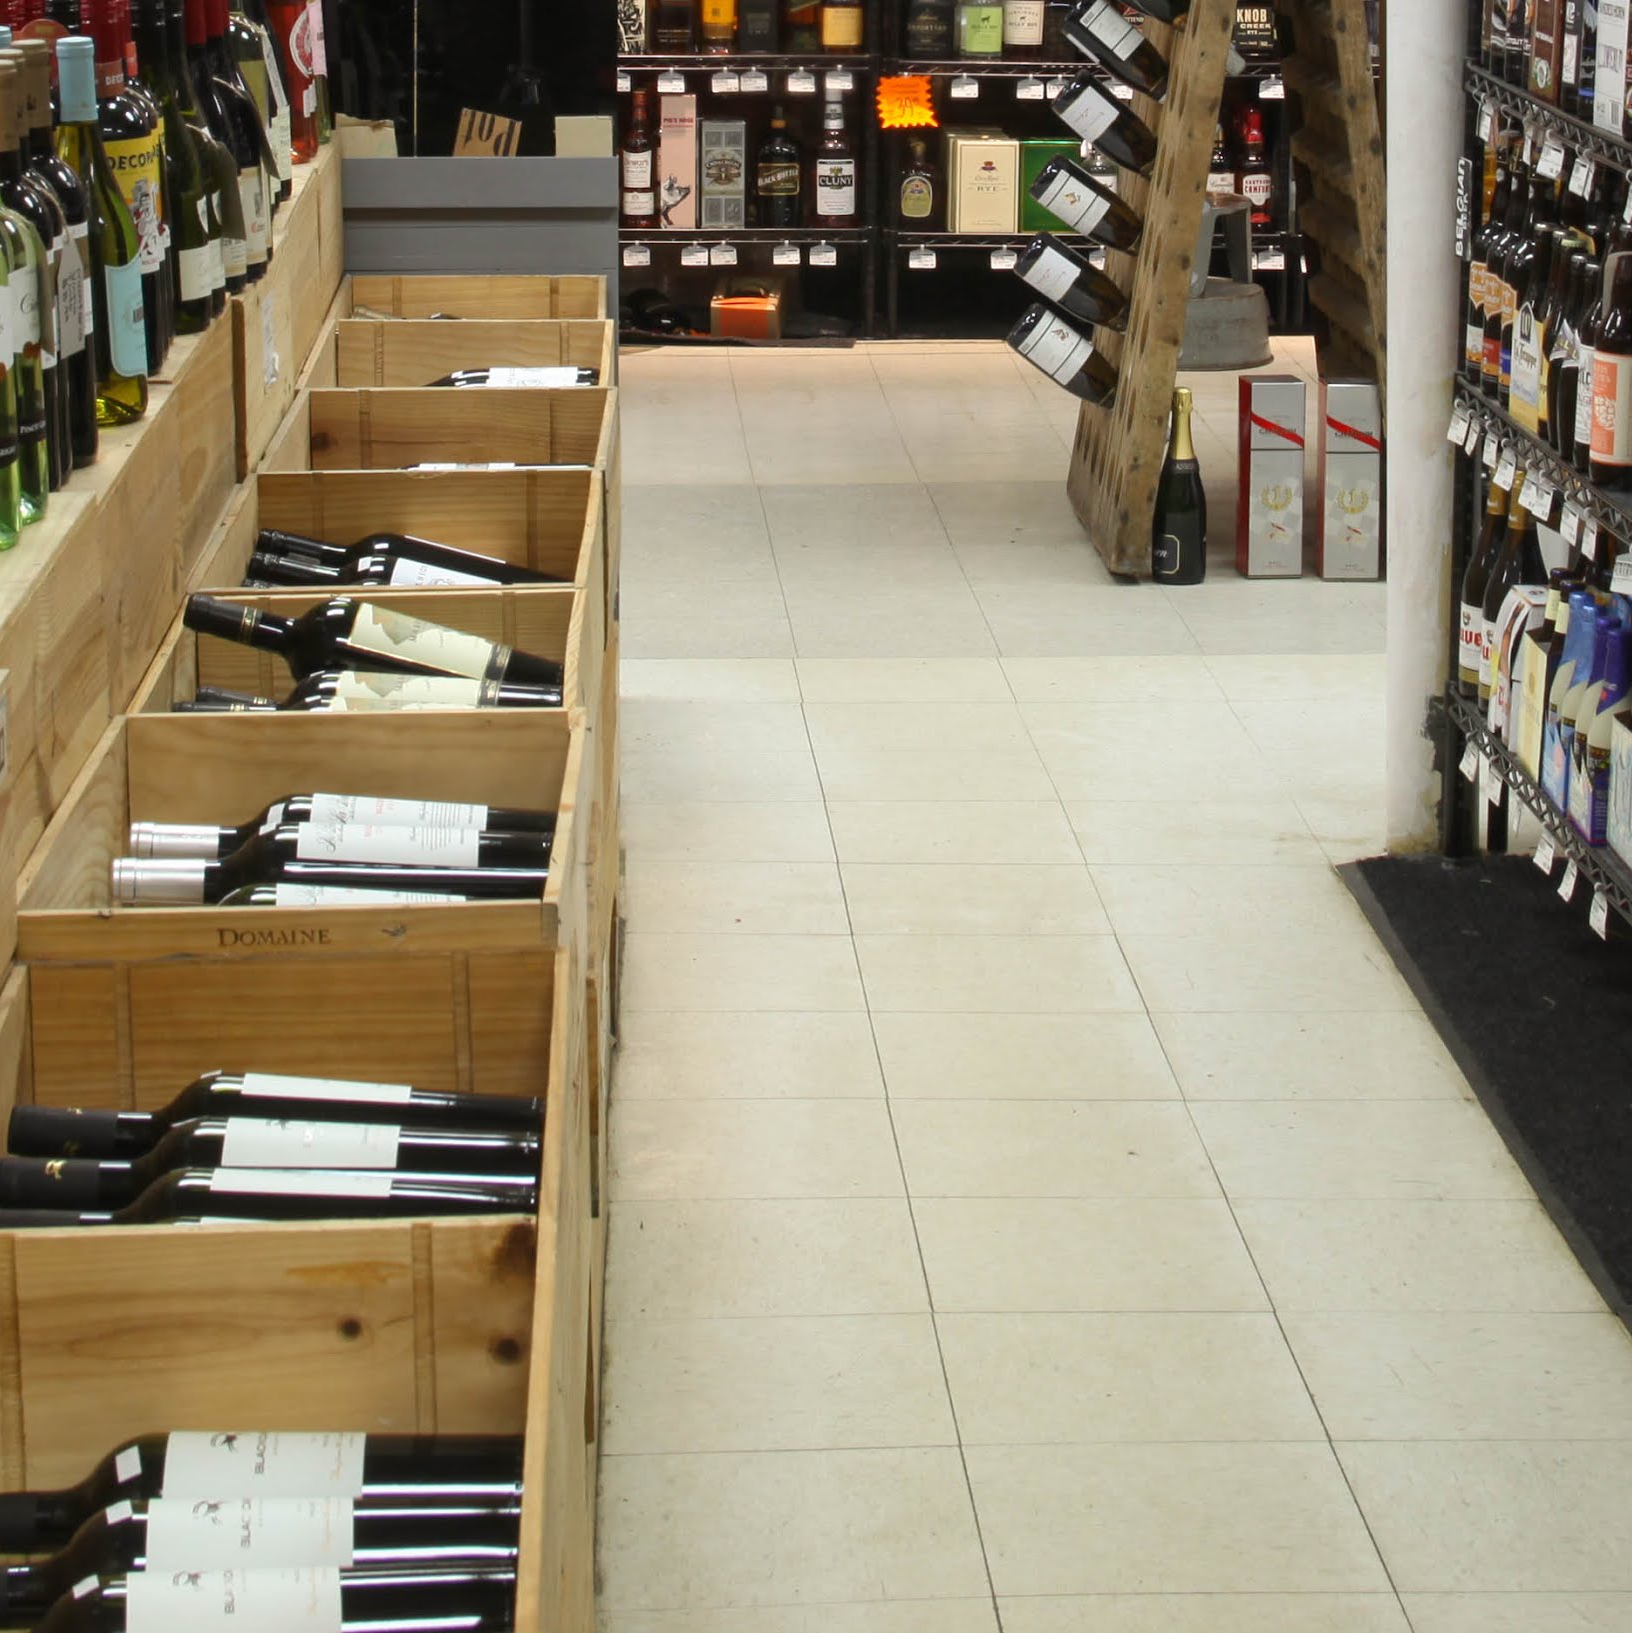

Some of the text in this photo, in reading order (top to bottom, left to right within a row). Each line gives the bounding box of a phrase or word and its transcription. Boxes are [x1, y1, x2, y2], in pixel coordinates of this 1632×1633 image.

[1237, 9, 1267, 22] KNOB
[819, 176, 853, 186] CLUNY
[1454, 158, 1468, 255] BELGIAN
[217, 928, 332, 946] DOMAINE
